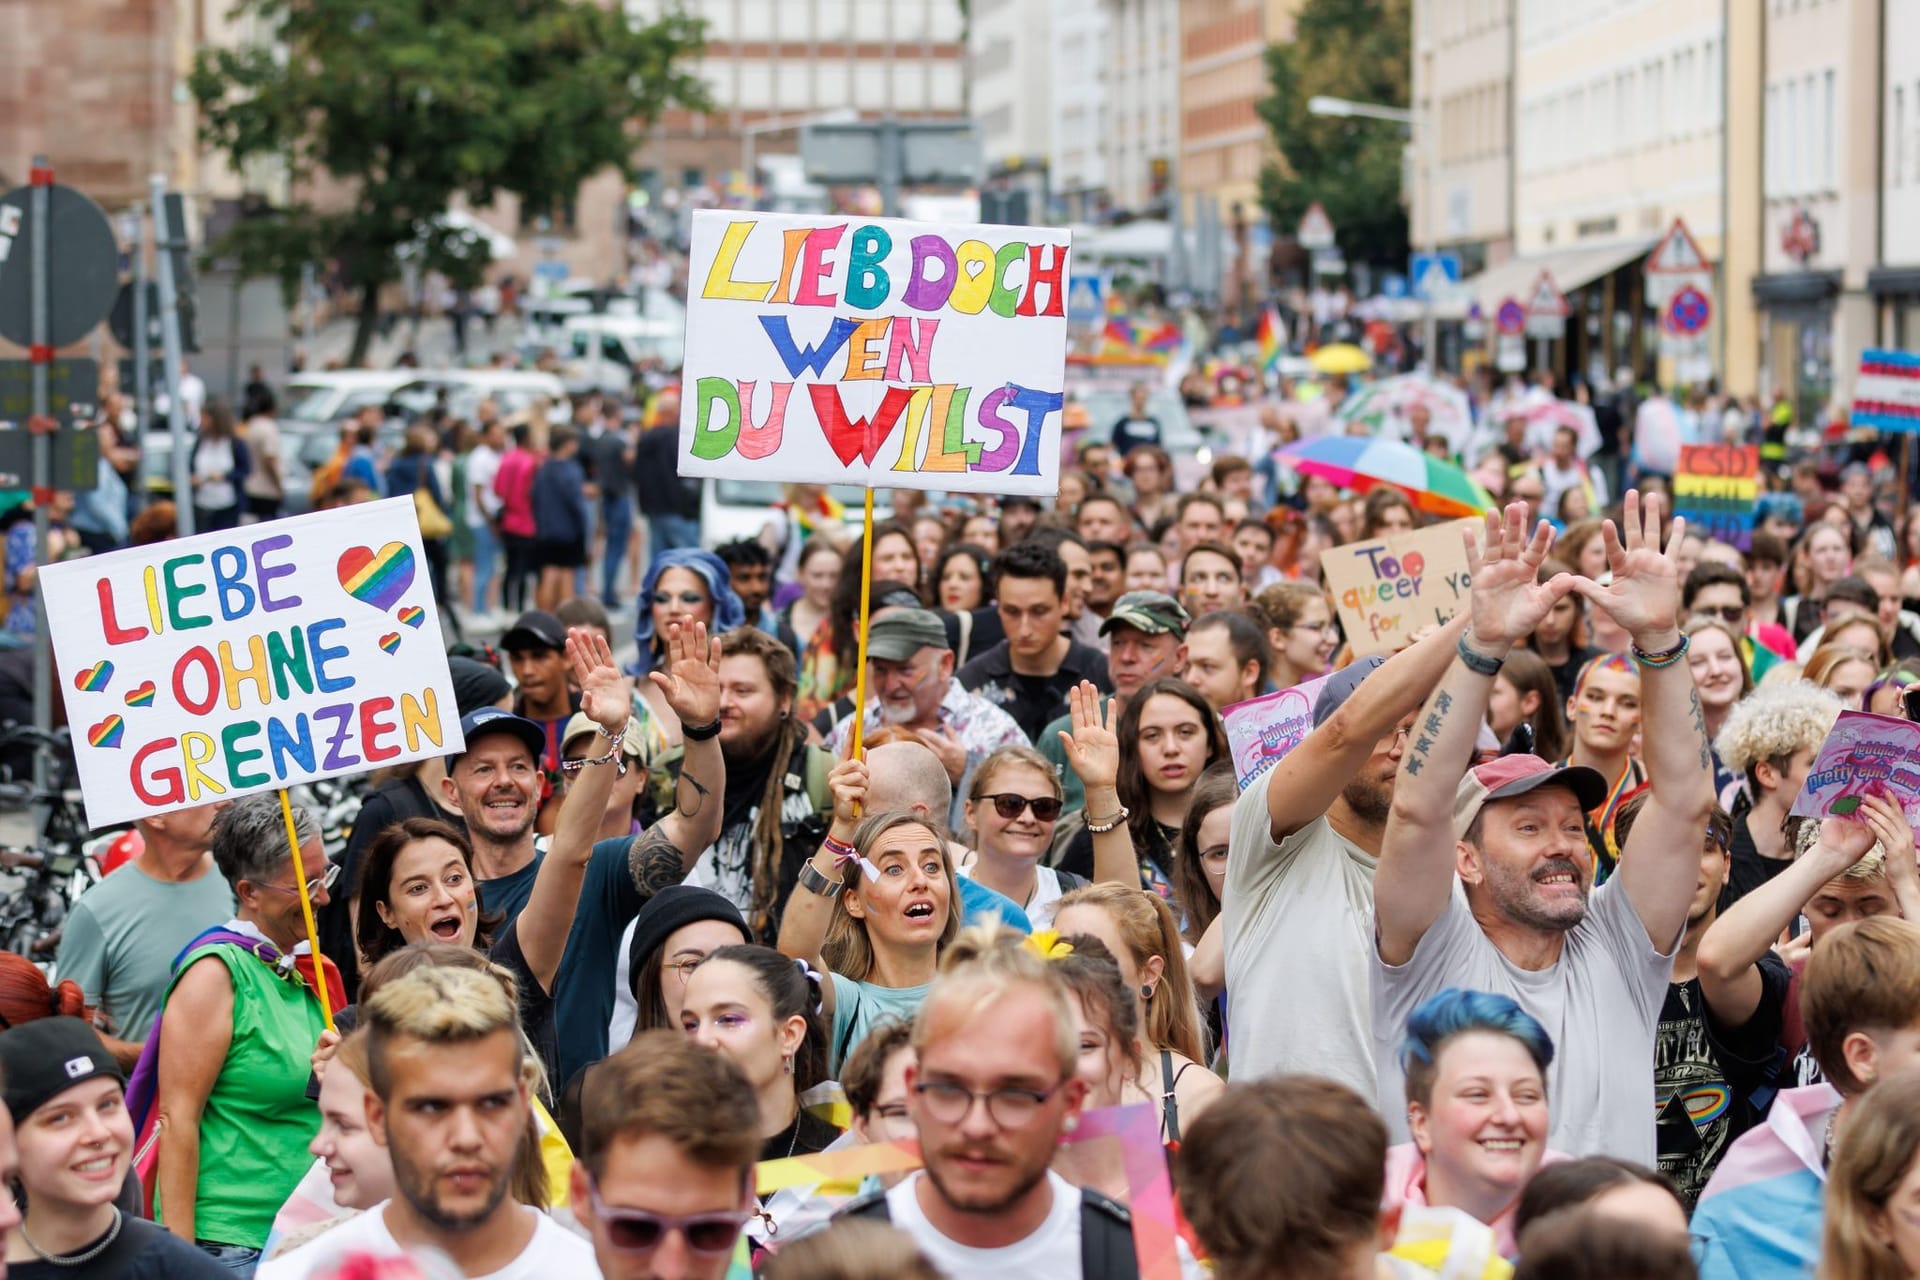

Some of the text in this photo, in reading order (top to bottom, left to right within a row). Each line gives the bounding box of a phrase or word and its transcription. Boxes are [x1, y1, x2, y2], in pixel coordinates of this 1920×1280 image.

[701, 221, 1069, 318] LIEB DOCH
[758, 315, 941, 384] WEN
[690, 376, 1064, 476] DU WILLST
[1686, 445, 1747, 477] CSD
[96, 534, 304, 646] LIEBE
[1342, 575, 1423, 621] queer
[1444, 572, 1472, 600] yo
[1369, 612, 1402, 642] for
[171, 617, 357, 716] OHNE
[129, 687, 445, 806] GRENZEN
[1807, 764, 1854, 795] pretty
[1856, 763, 1893, 782] epic
[1664, 1066, 1693, 1080] 1972
